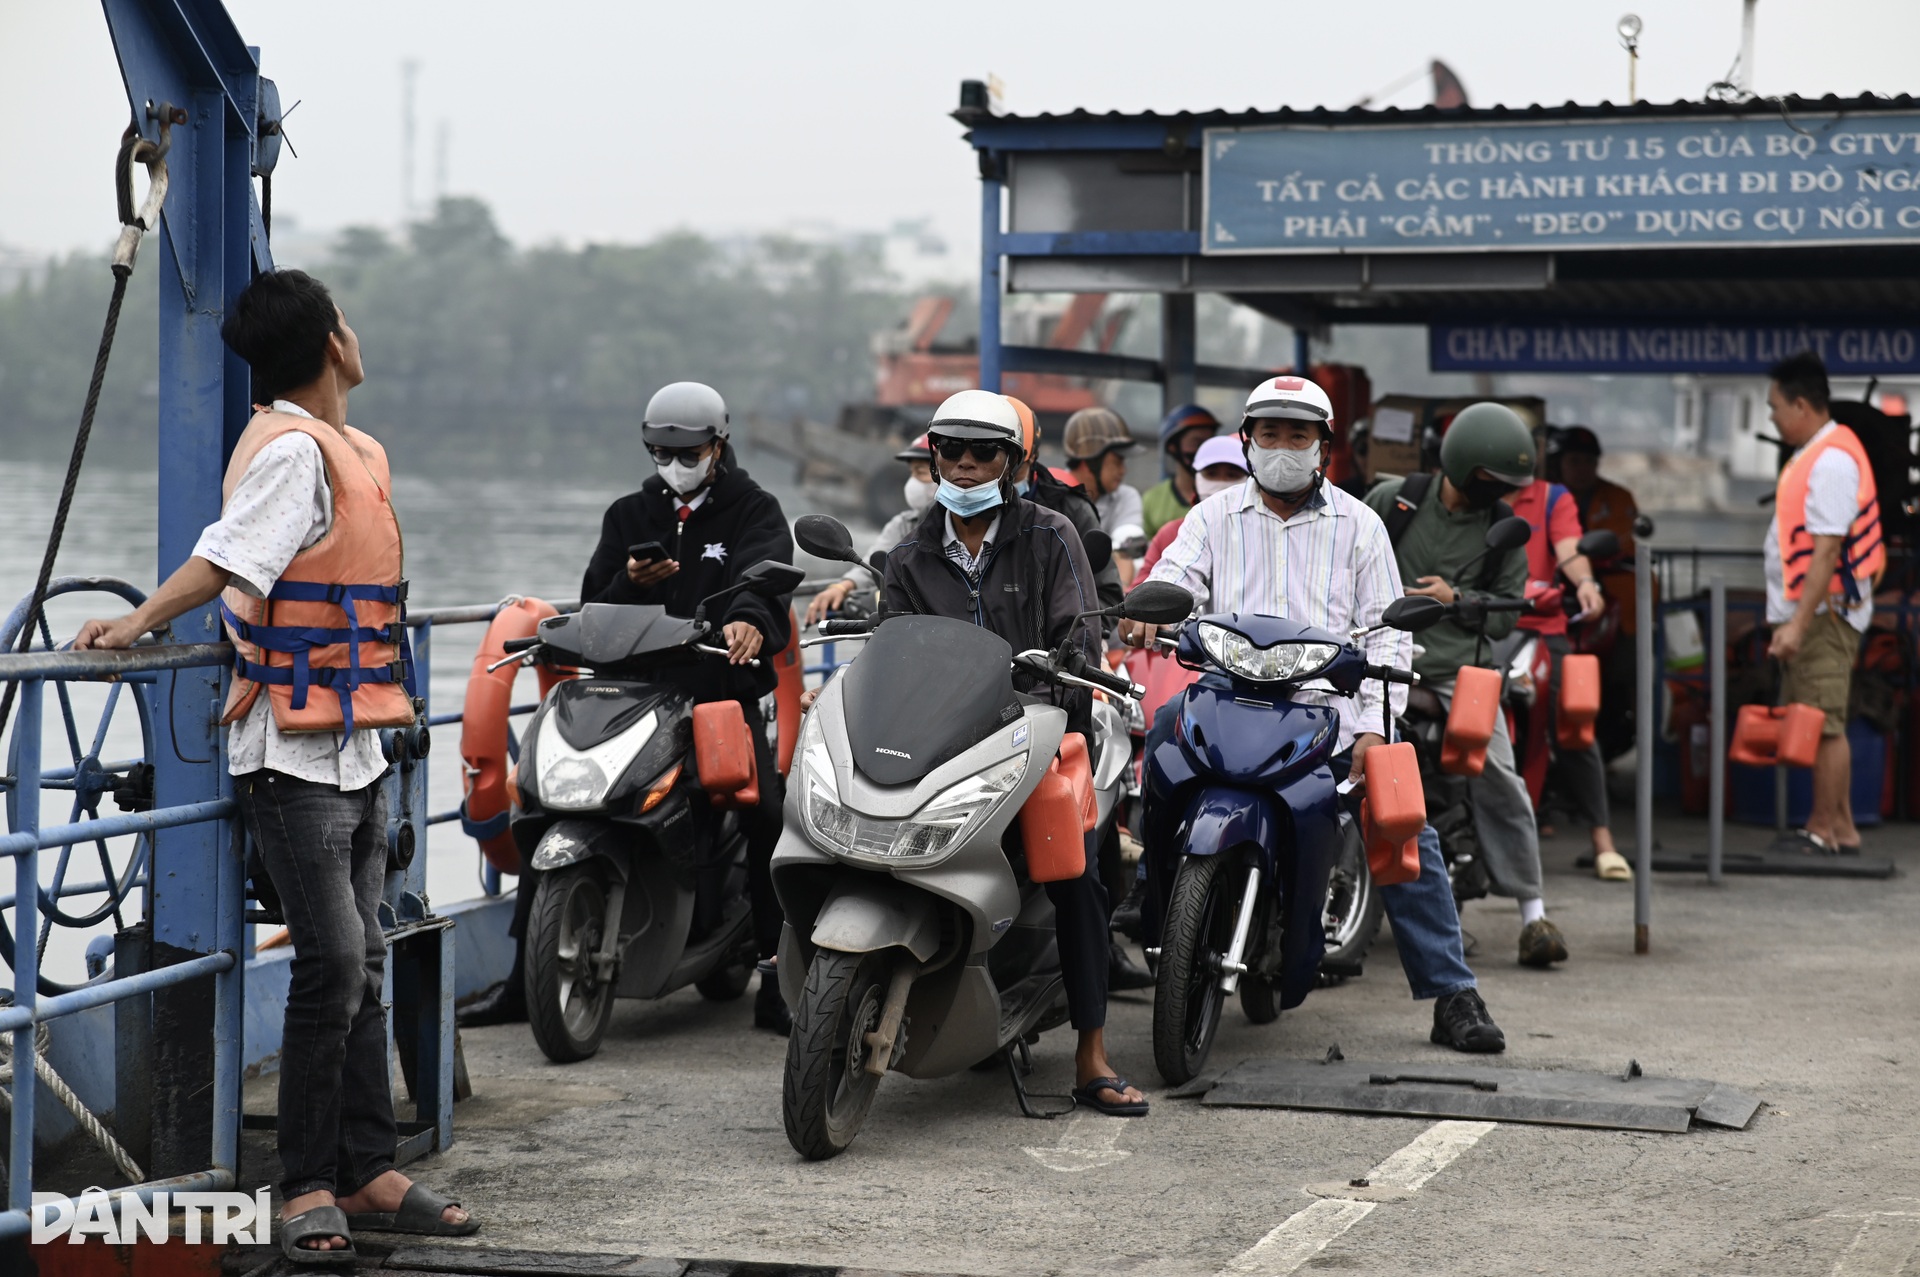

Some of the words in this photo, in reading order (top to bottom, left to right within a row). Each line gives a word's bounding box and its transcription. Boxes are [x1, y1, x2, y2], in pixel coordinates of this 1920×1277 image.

[1423, 136, 1551, 165] THÔNG
[1561, 135, 1613, 161] TƯ
[1624, 137, 1665, 160] 15
[1676, 128, 1754, 158] CỦA
[1257, 170, 1325, 202] TẤT
[1335, 173, 1384, 201] CẢ
[1395, 173, 1470, 201] CÁC
[1480, 170, 1584, 200] HÀNH
[1596, 167, 1728, 197] KHÁCH
[1739, 171, 1779, 195] ĐI
[1790, 164, 1844, 193] ĐÒ
[1284, 209, 1367, 238] PHẢI
[1636, 207, 1743, 237] DỤNG
[1753, 207, 1805, 235] CỤ
[1818, 196, 1885, 230] NỔI
[1838, 328, 1915, 363] GIAO
[874, 747, 912, 760] HONDA
[663, 807, 689, 828] HONDA
